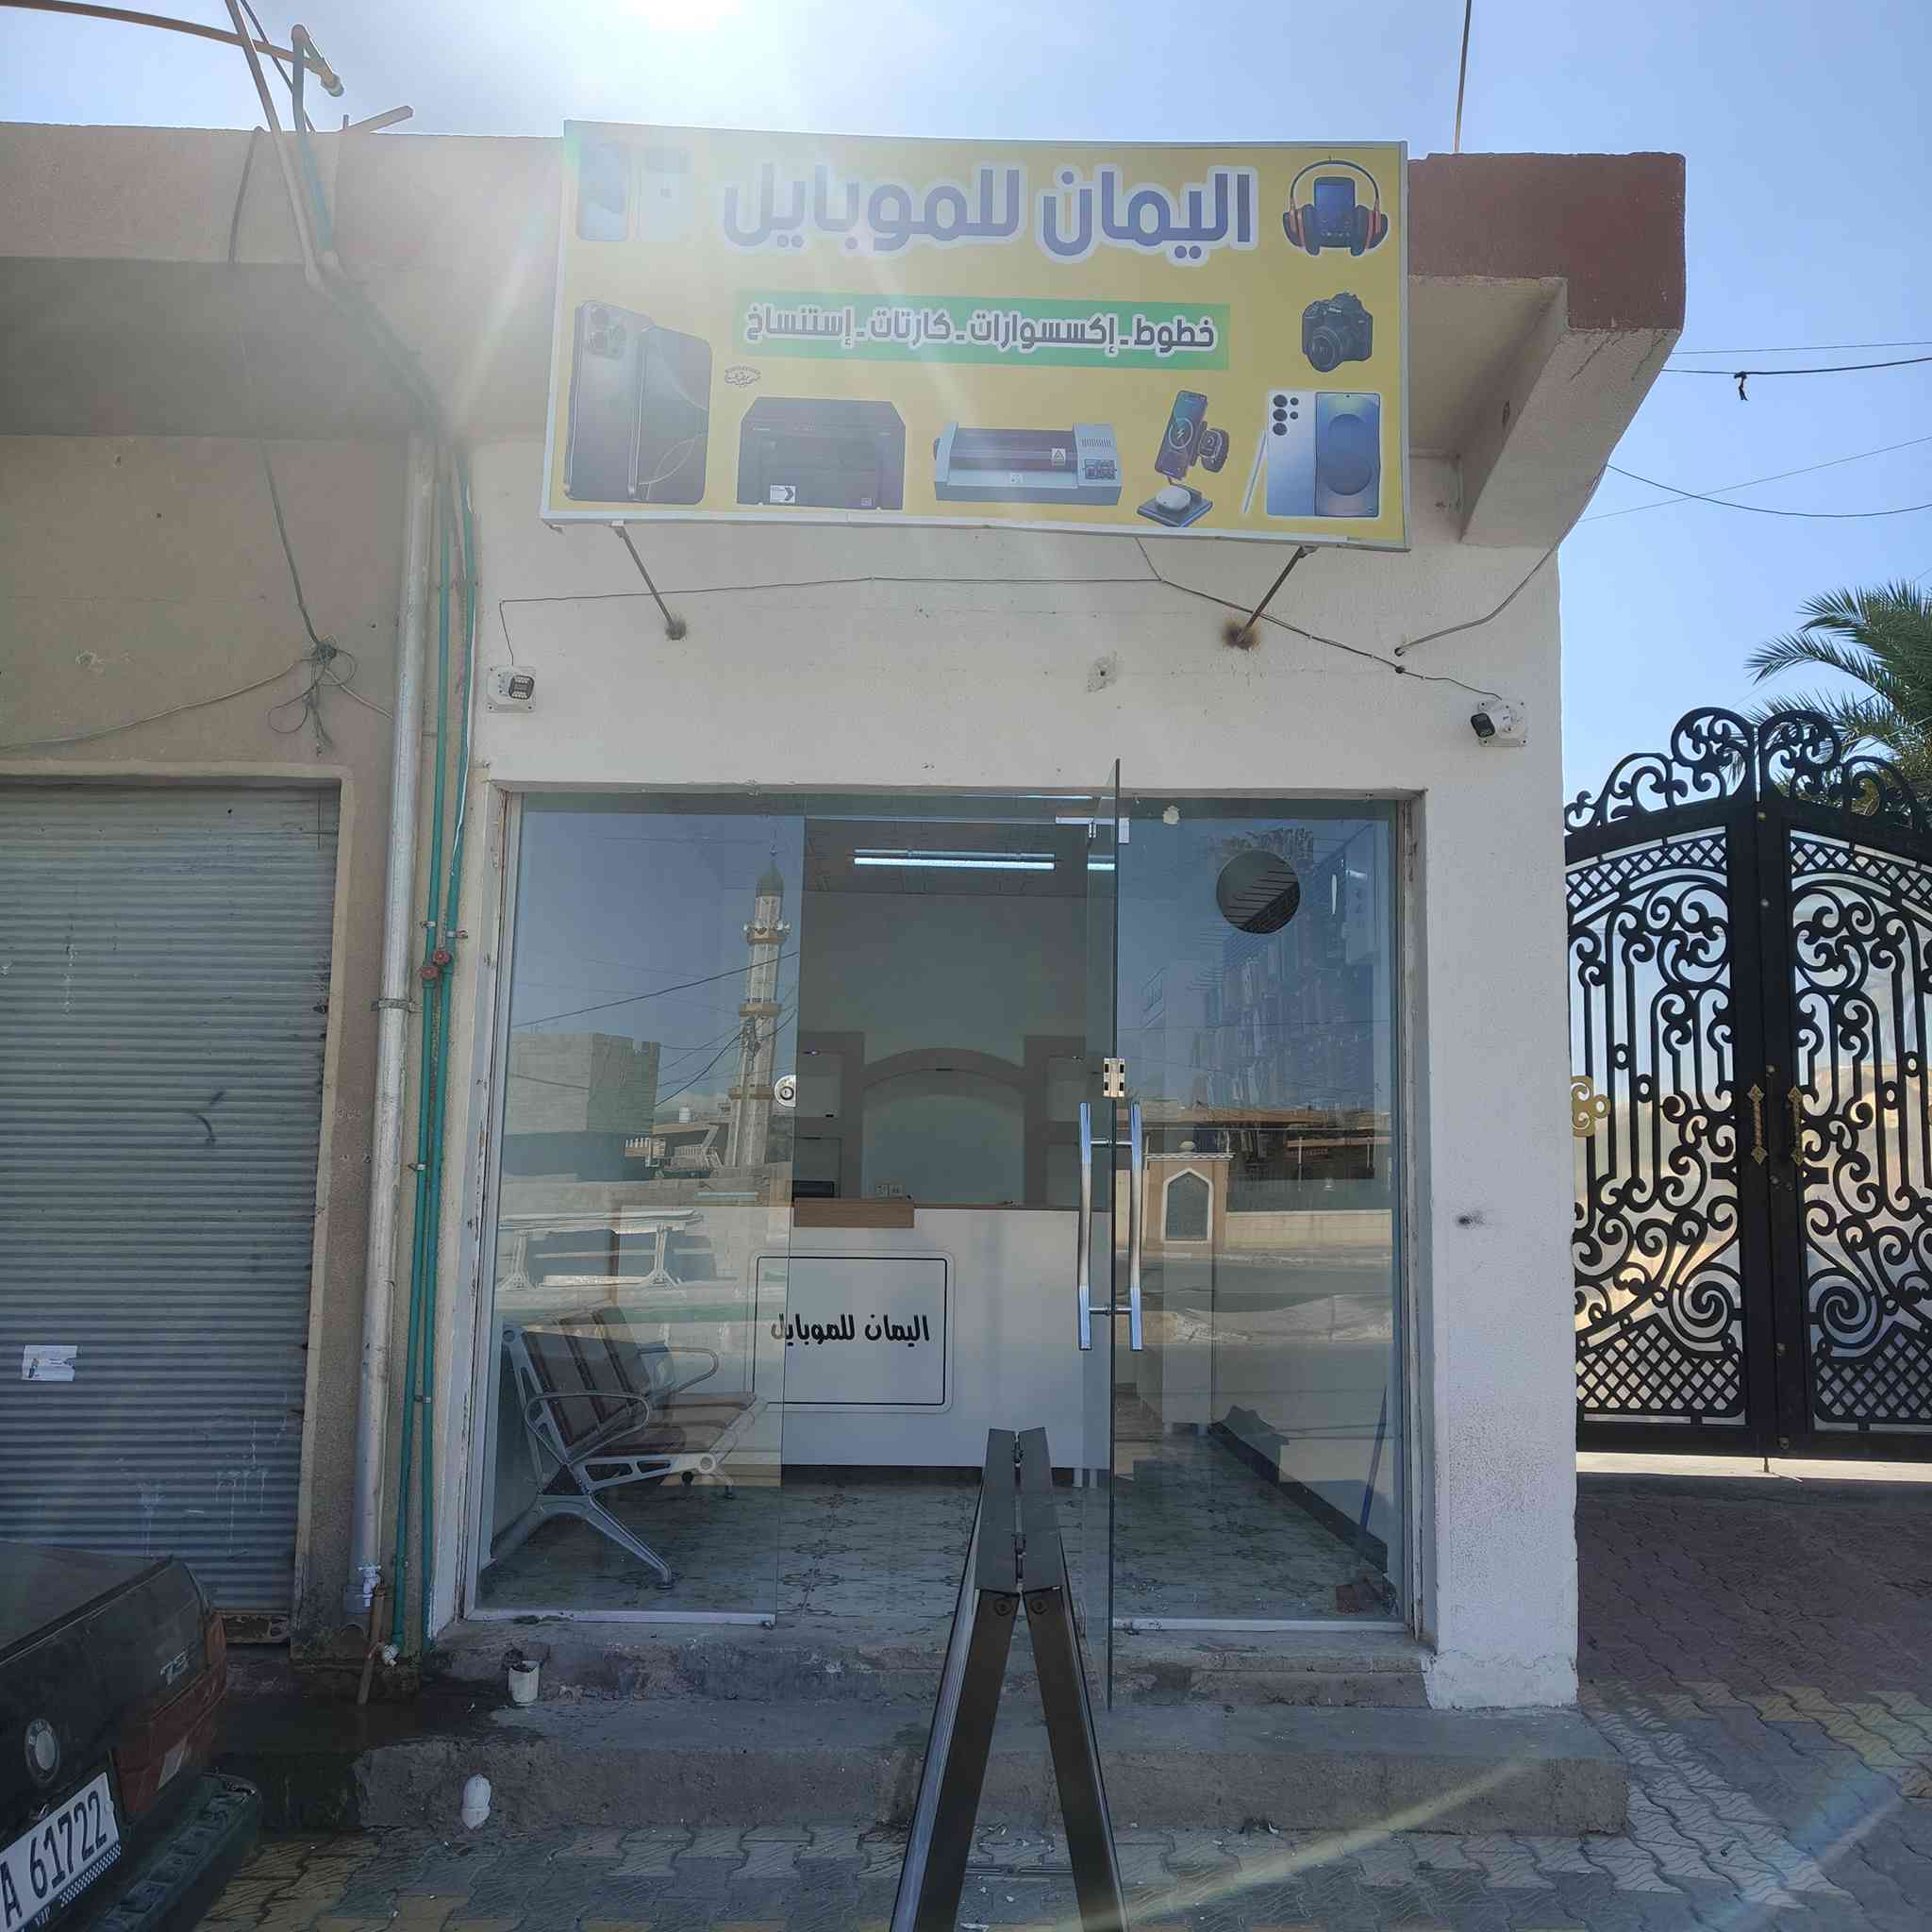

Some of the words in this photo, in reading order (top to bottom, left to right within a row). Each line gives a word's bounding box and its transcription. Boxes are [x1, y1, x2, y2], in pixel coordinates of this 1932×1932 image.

[724, 160, 1021, 252] للموبايل
[1041, 169, 1252, 258] اليمان
[771, 1312, 855, 1346] للموبايل
[864, 1313, 930, 1347] اليمان
[0, 1860, 23, 1928] A
[30, 1790, 108, 1899] 61722
